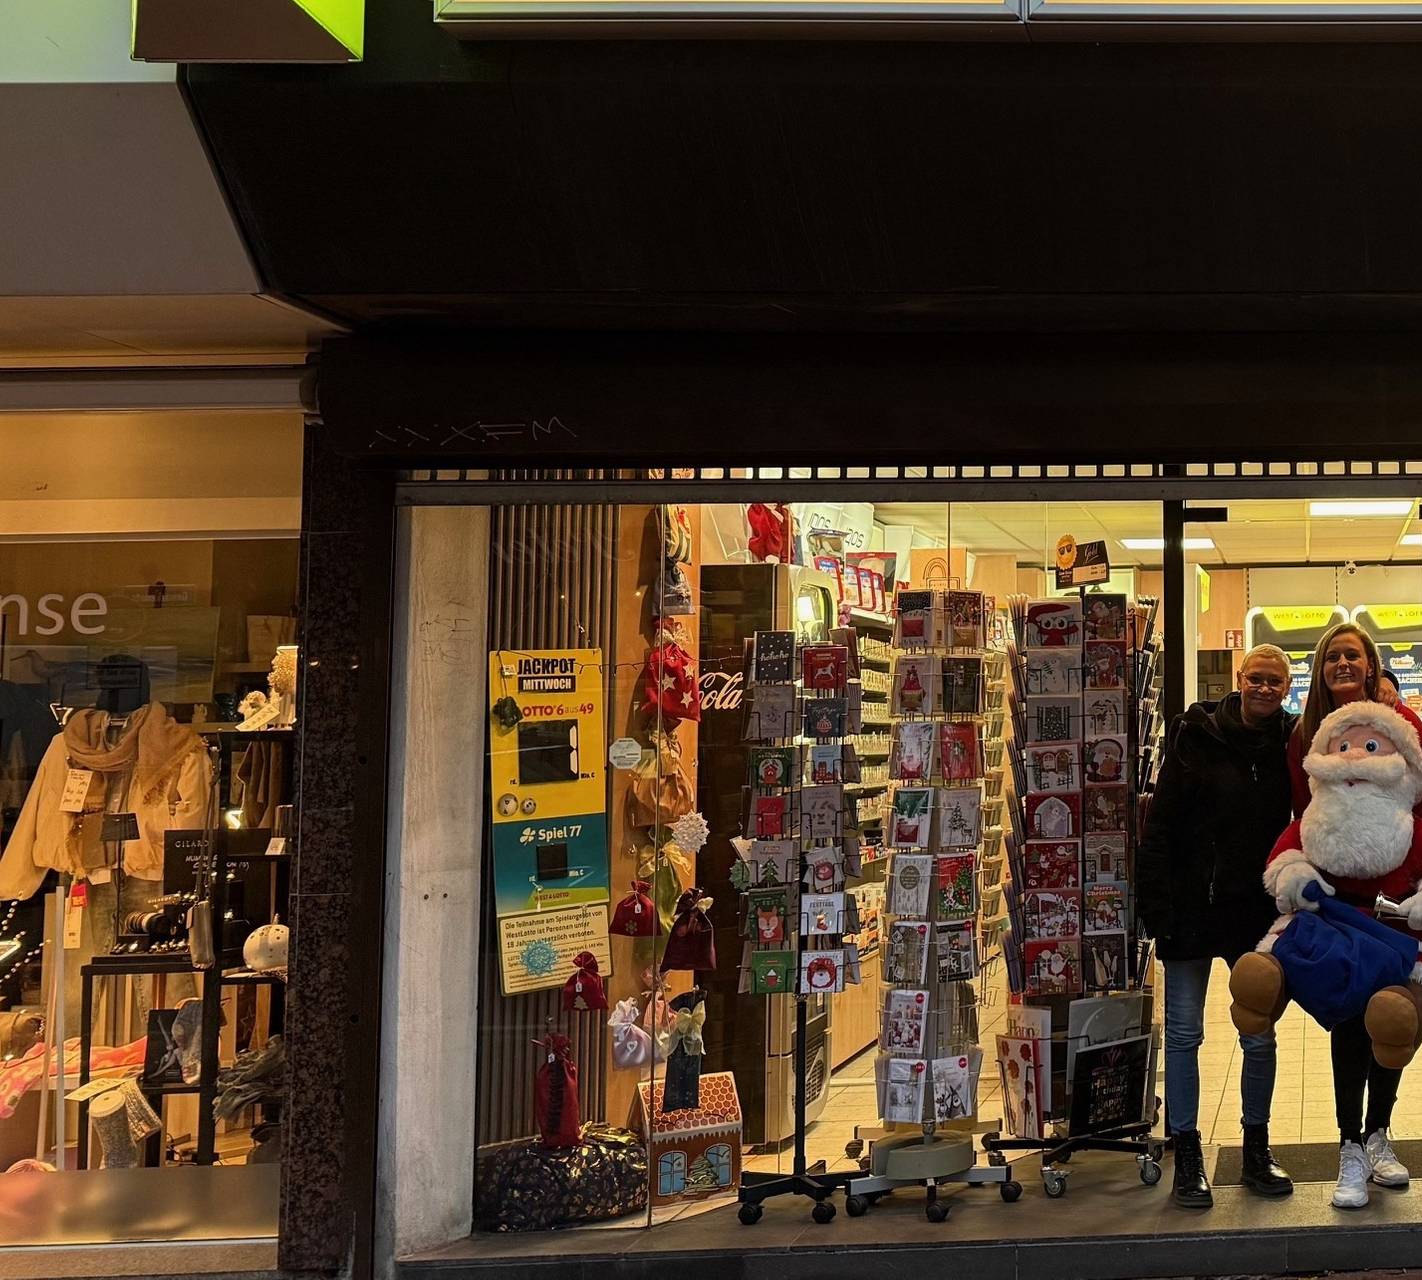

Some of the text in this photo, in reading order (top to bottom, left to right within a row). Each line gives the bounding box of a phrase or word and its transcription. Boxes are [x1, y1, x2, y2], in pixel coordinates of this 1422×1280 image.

[518, 658, 576, 675] JACKPOT
[523, 678, 572, 691] MITTWOCH
[521, 705, 554, 717] OTTO
[556, 704, 564, 716] 6
[579, 703, 594, 715] 49
[538, 825, 582, 842] Spiel 77
[516, 918, 545, 927] Teilnahme
[505, 929, 536, 939] WestLotto
[546, 924, 573, 932] Personen
